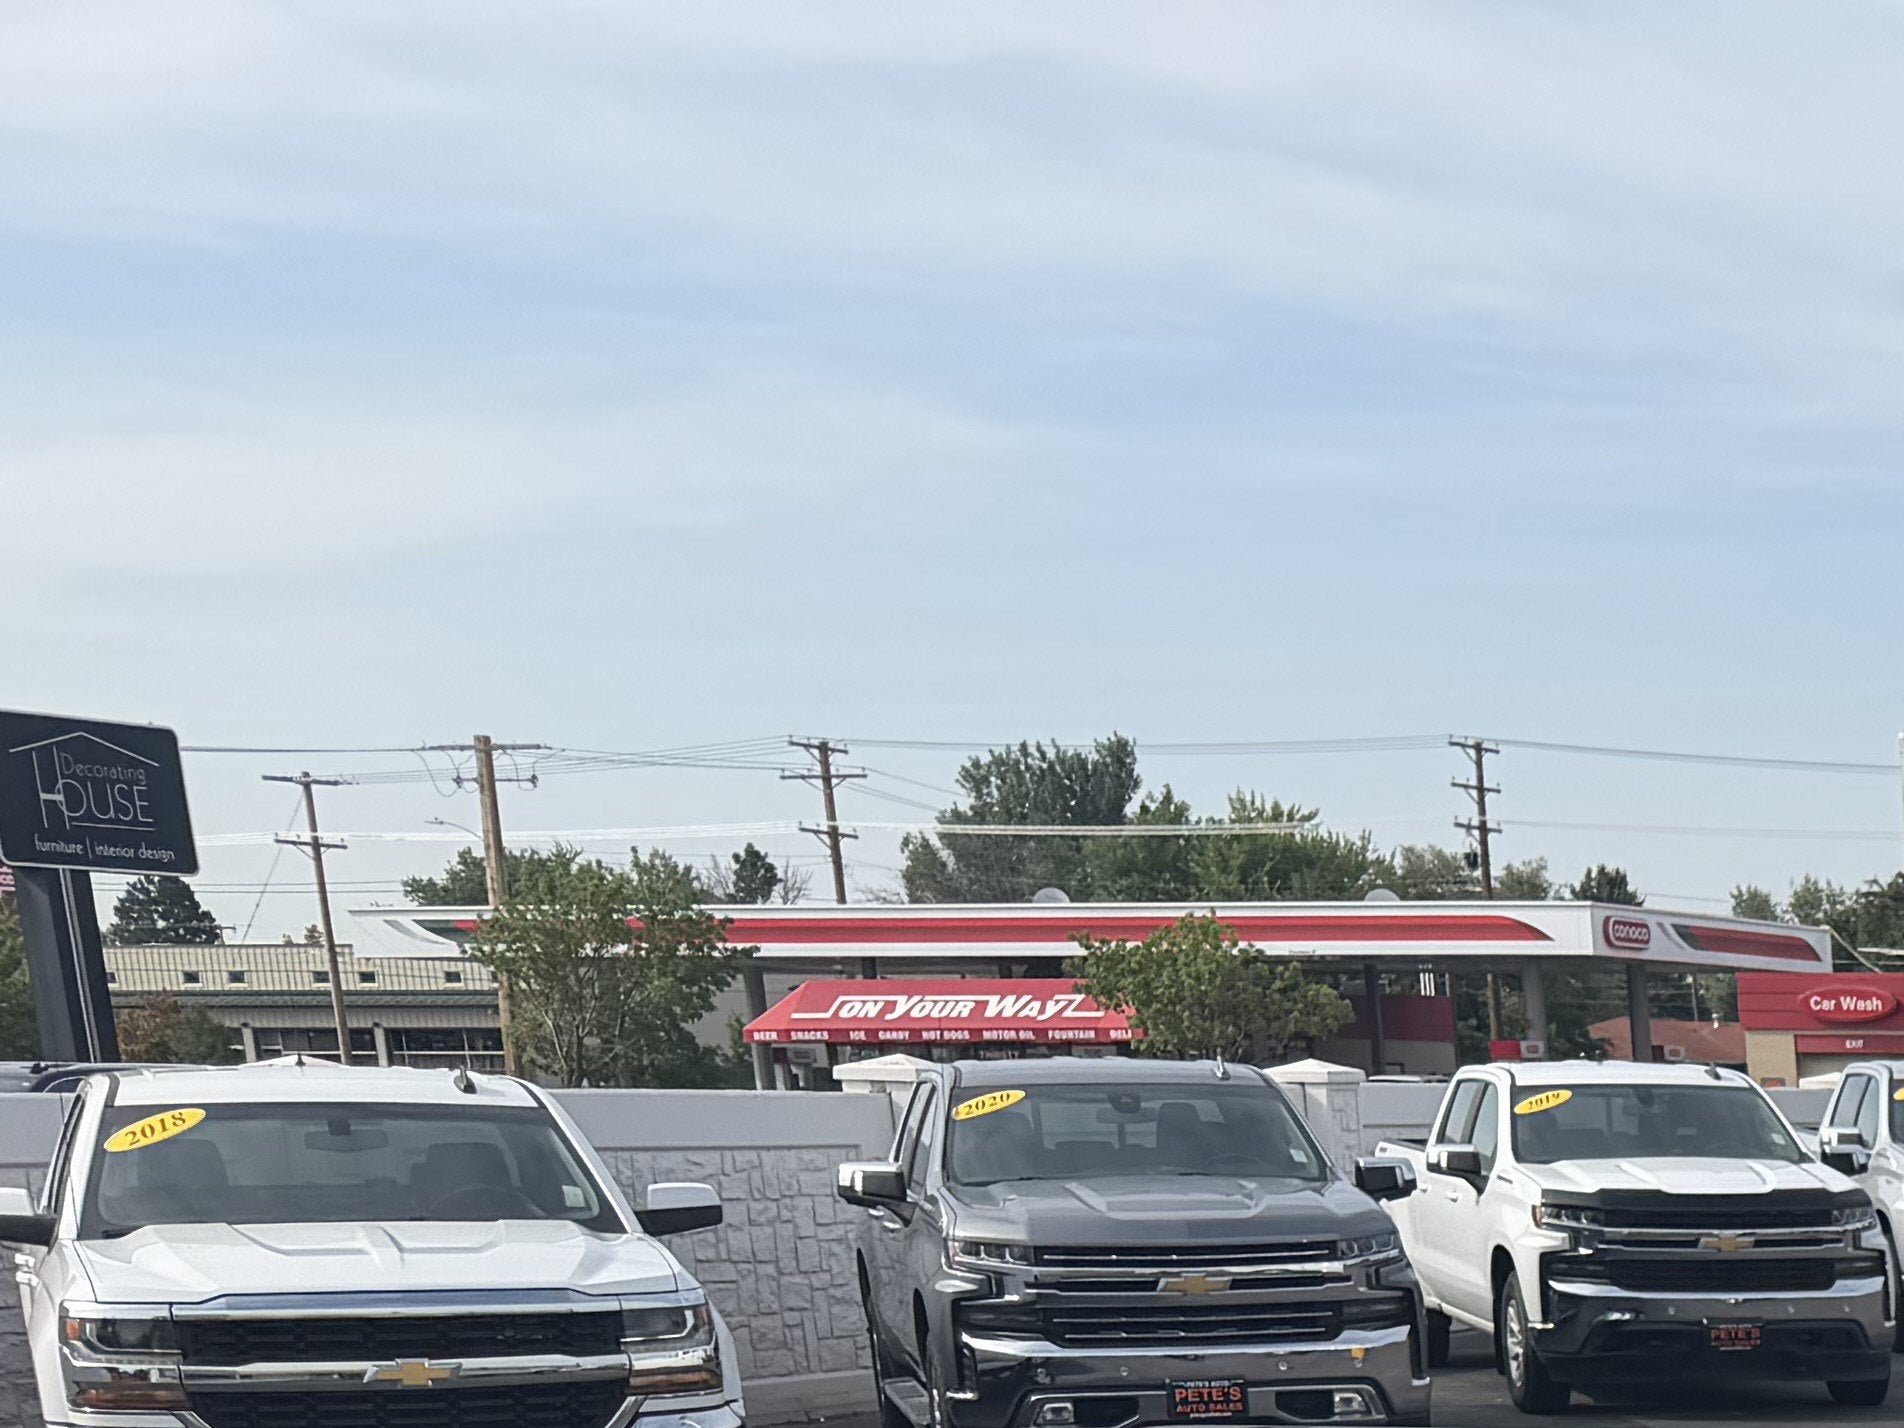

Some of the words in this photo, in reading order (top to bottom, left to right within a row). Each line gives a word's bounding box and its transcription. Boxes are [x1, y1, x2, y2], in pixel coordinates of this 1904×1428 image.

[60, 751, 147, 785] Decorating
[94, 841, 136, 859] interior
[138, 842, 177, 864] design
[838, 1000, 885, 1019] ON
[884, 995, 976, 1021] YOUR
[984, 995, 1069, 1021] WAY
[1809, 996, 1836, 1011] Car
[1840, 996, 1883, 1011] Wash
[963, 1092, 1011, 1115] 2020
[125, 1111, 186, 1146] 2018
[1175, 1386, 1242, 1402] PETE'S
